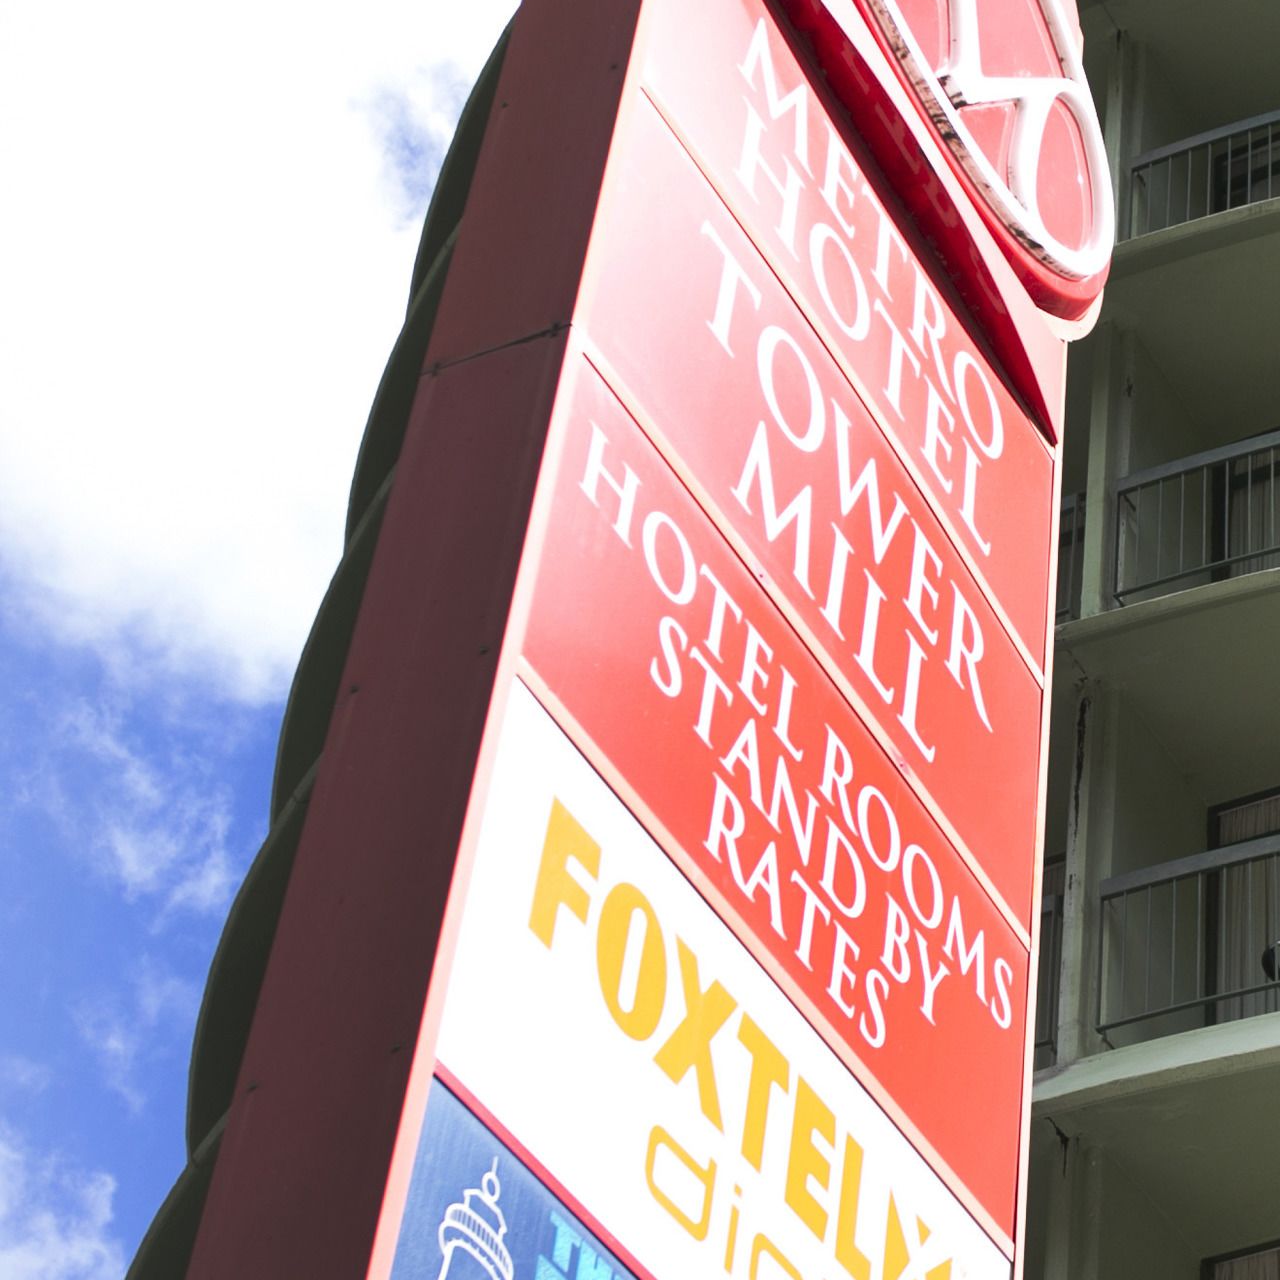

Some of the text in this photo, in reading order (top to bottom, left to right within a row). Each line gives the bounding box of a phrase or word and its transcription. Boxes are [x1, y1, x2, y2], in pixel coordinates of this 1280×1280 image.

[733, 95, 991, 556] HOTEL
[738, 17, 1003, 459] METRO
[701, 222, 993, 732] TOWER
[730, 420, 936, 762] MILL
[579, 420, 1012, 1028] HOTEL ROOMS
[703, 772, 889, 1048] RATES
